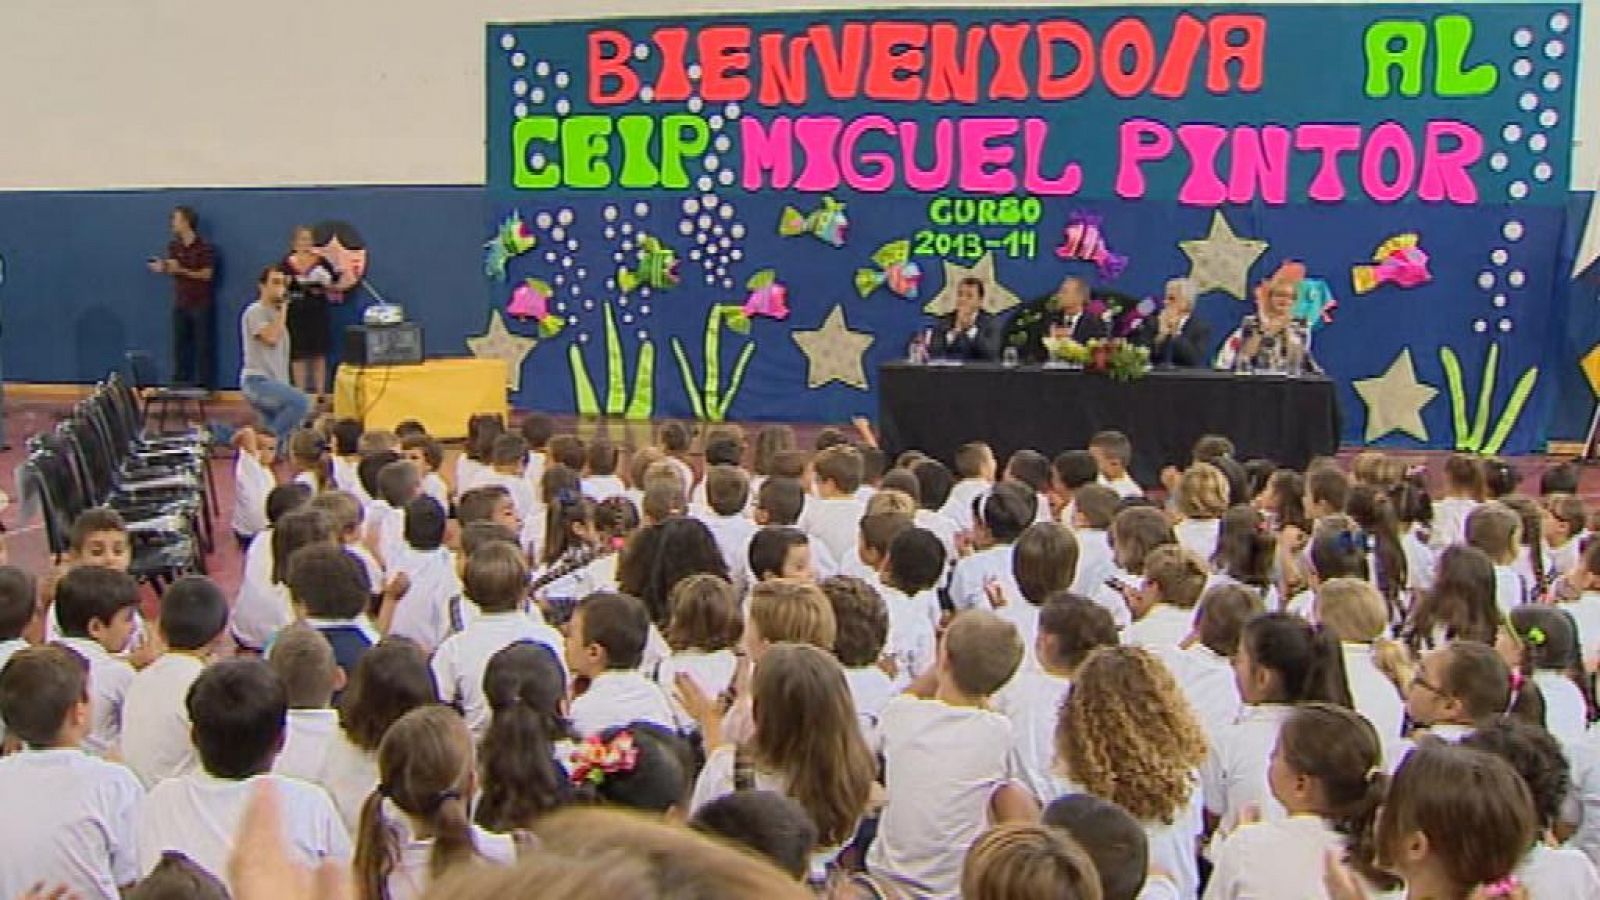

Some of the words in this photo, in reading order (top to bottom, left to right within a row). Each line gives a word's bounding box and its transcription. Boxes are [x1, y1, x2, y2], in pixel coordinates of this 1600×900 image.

[588, 15, 1266, 104] BIENVENIDO/A
[1365, 15, 1498, 96] AL
[513, 115, 710, 190] CEIP
[741, 115, 1083, 194] MIGUEL
[1116, 119, 1484, 203] PINTOR
[914, 230, 1037, 257] 2013-14
